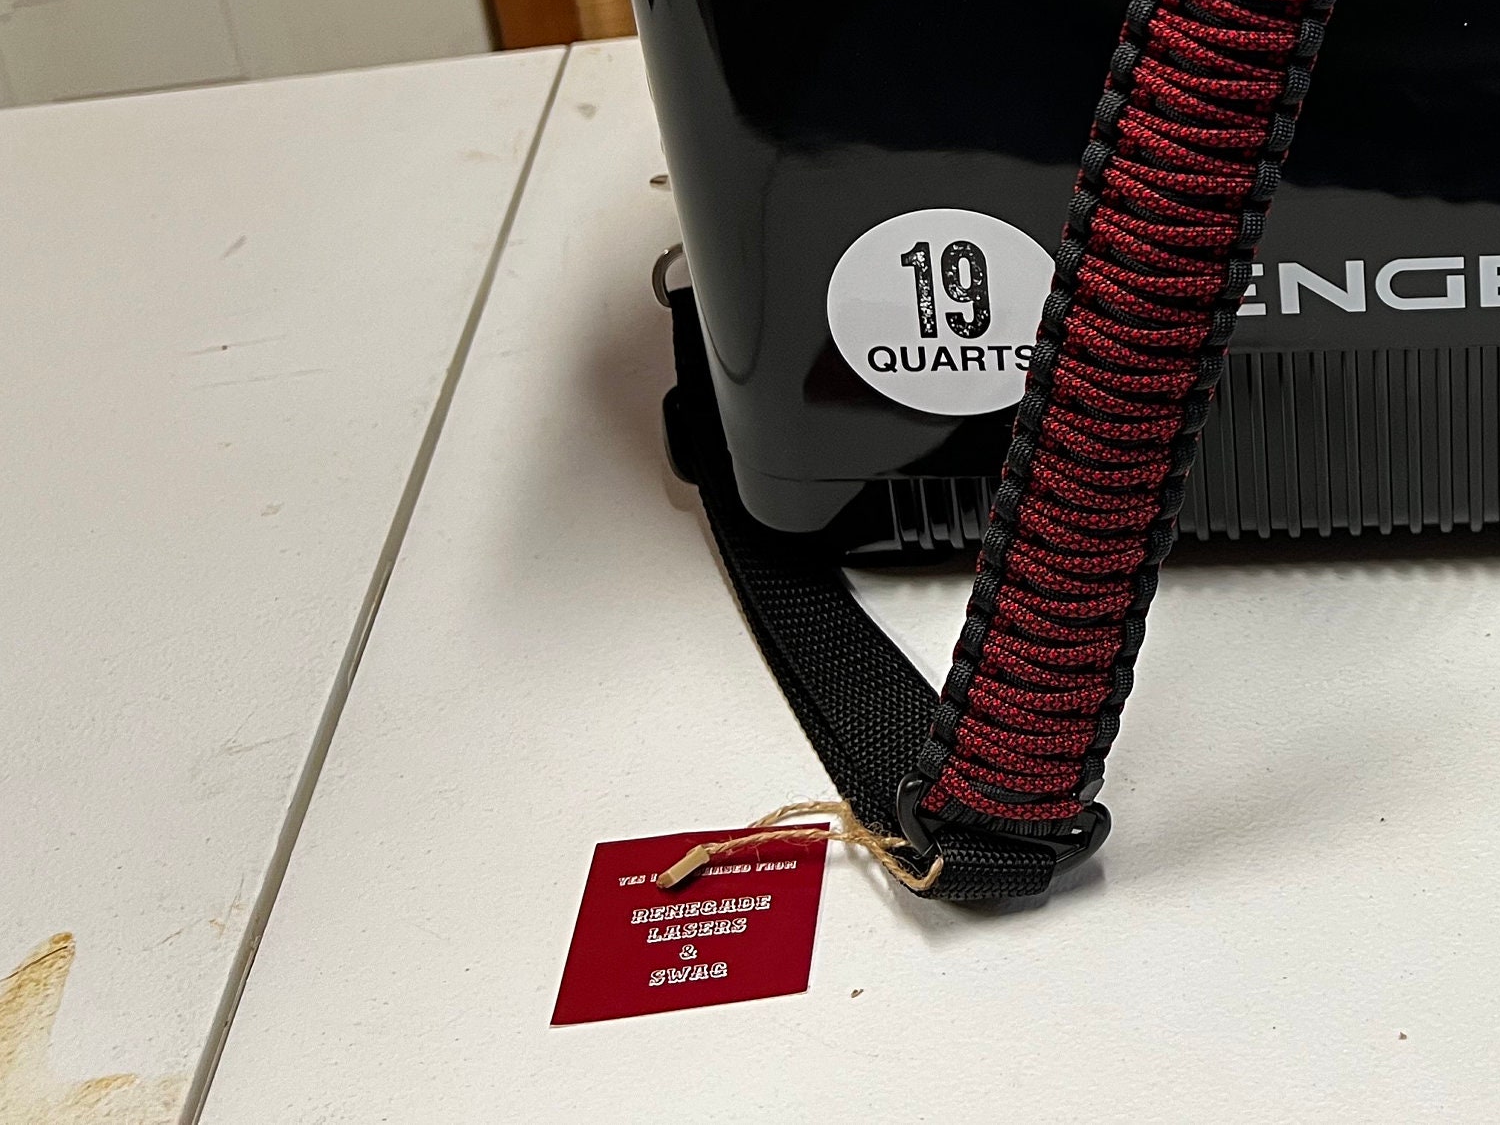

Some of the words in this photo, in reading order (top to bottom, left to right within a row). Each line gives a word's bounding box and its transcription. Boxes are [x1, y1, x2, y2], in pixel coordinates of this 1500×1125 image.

[900, 240, 992, 339] 19
[867, 345, 1035, 373] QUARTS
[618, 874, 646, 887] YES
[755, 860, 797, 871] FROM
[631, 895, 772, 925] RENEGADE
[646, 917, 748, 944] LASERS
[679, 944, 698, 961] &
[648, 961, 728, 987] SWAG
